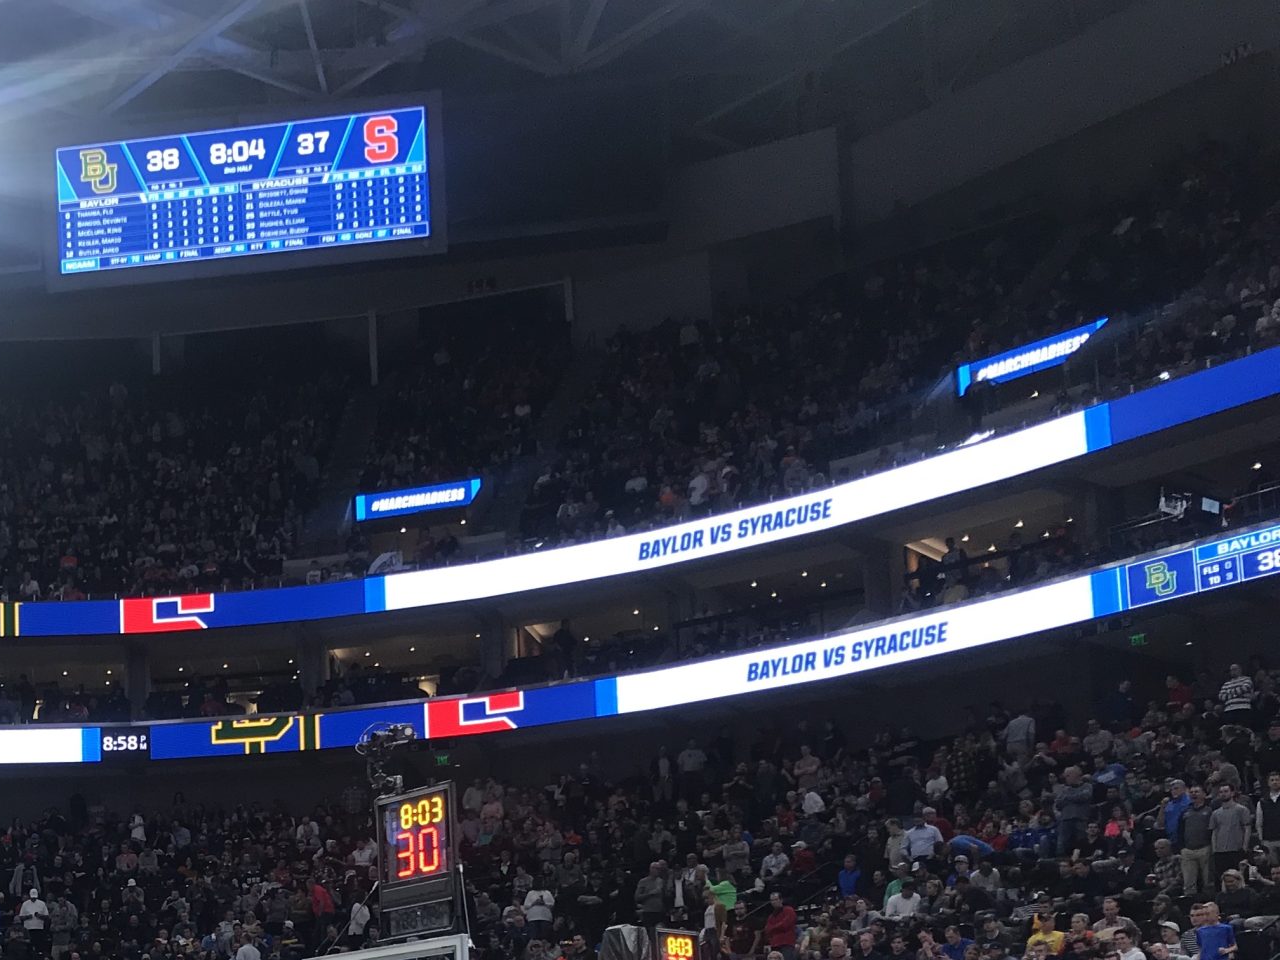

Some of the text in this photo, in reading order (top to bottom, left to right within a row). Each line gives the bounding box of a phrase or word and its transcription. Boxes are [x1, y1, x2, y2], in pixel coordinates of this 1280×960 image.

[209, 138, 266, 166] 8:04
[297, 131, 330, 156] 37
[363, 115, 399, 164] S
[80, 149, 117, 193] BU
[146, 148, 180, 172] 38
[237, 164, 253, 174] HALF
[79, 197, 118, 209] BAYLOR
[638, 498, 833, 561] BAYLOR VS SYRACUSE
[1203, 565, 1219, 575] FLS
[1209, 575, 1221, 585] TO
[747, 621, 948, 682] BAYLOR VS SYRACUSE
[102, 735, 138, 752] 8:58
[400, 797, 443, 830] 8:03
[397, 827, 439, 877] 30
